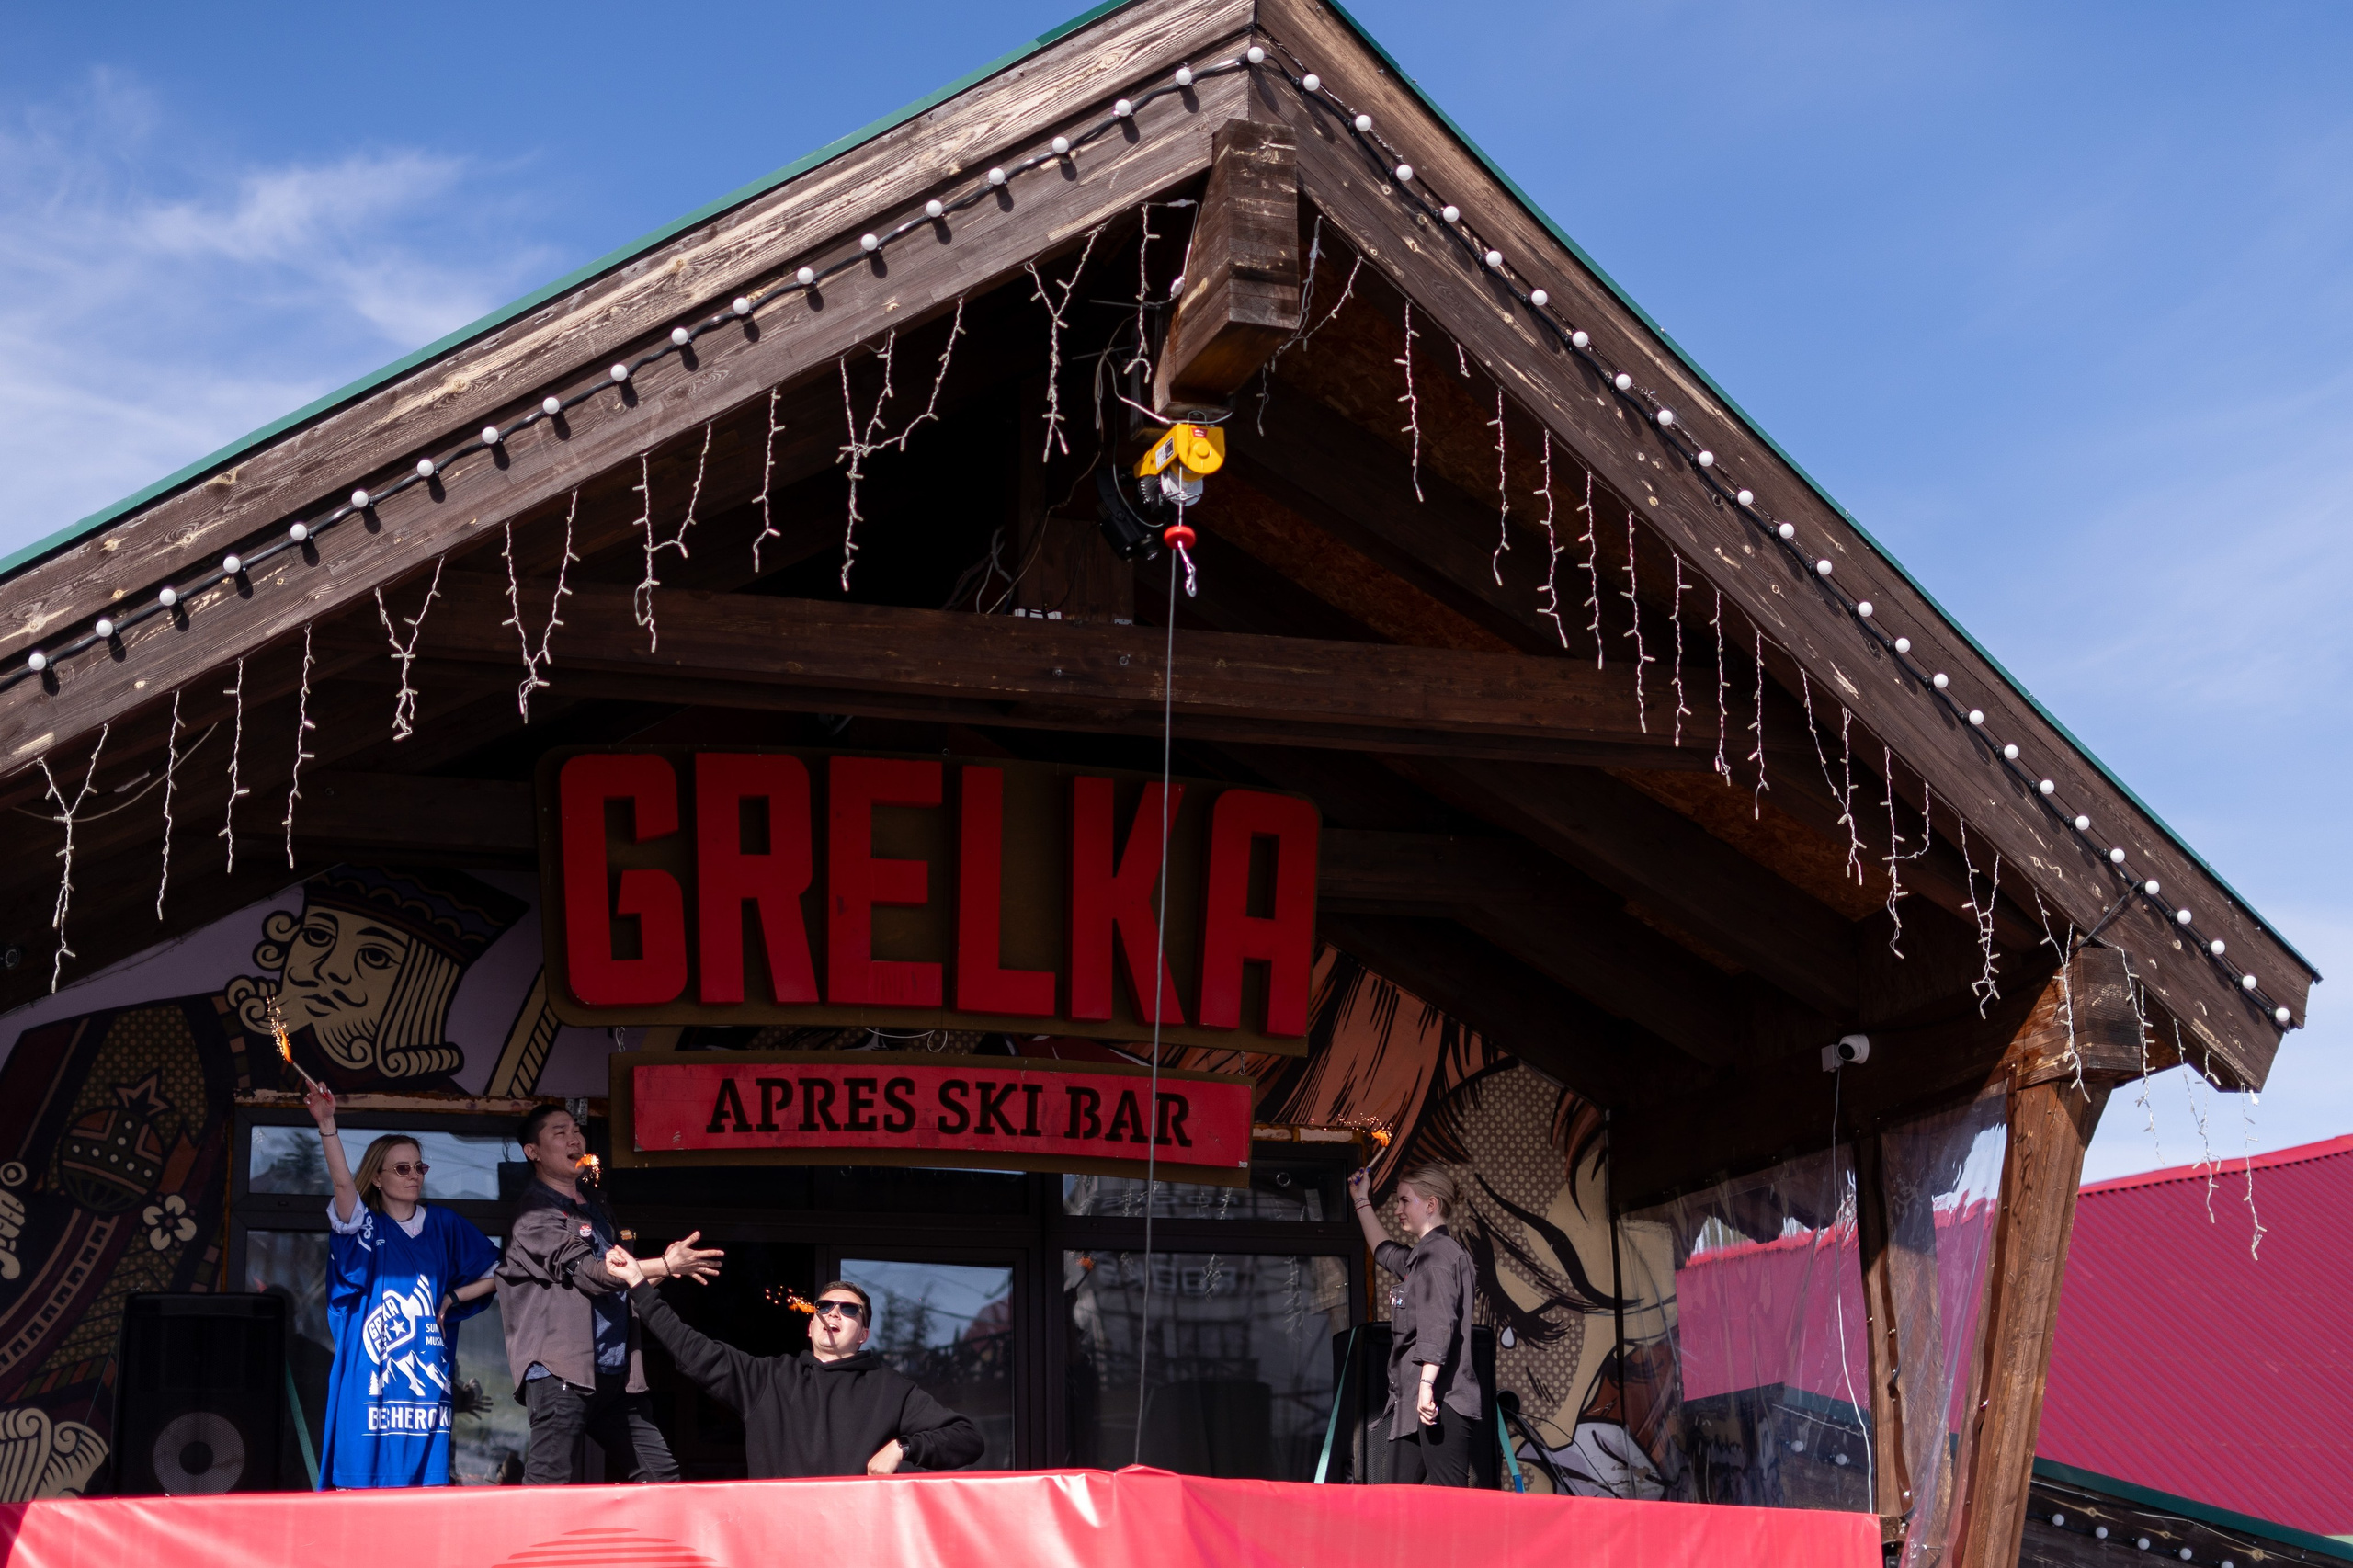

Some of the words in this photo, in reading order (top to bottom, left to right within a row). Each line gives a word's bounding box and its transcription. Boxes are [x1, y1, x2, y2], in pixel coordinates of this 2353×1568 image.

[559, 751, 1321, 1040] GRELKA
[706, 1077, 916, 1134] APRES
[937, 1079, 1044, 1138] SKI
[1063, 1085, 1193, 1148] BAR
